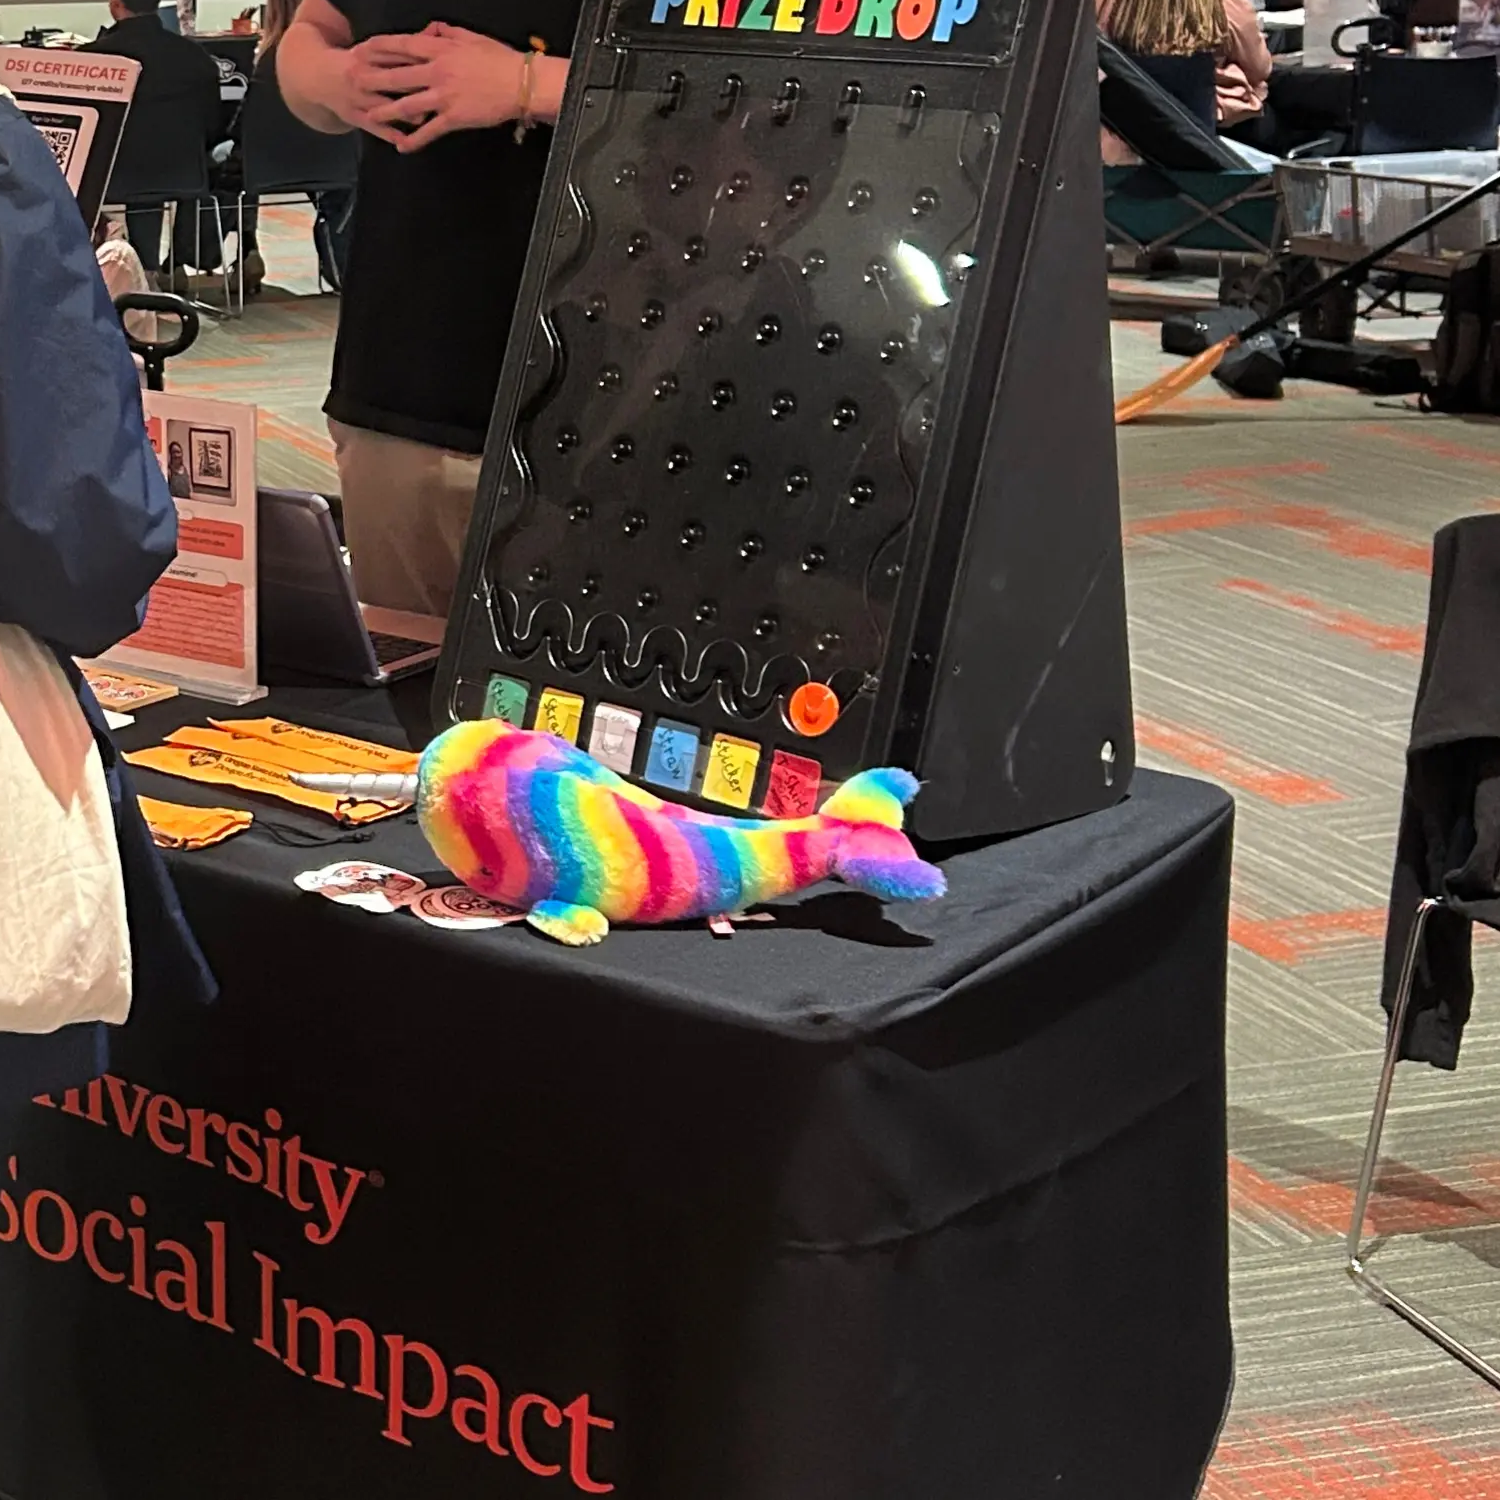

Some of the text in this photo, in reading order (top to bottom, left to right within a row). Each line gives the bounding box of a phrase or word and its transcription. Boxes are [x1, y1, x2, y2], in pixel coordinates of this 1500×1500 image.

[5, 58, 129, 81] DSI CERTIFICATE
[716, 738, 743, 794] Sticker
[31, 1074, 366, 1245] iversity
[252, 1250, 615, 1494] Impact
